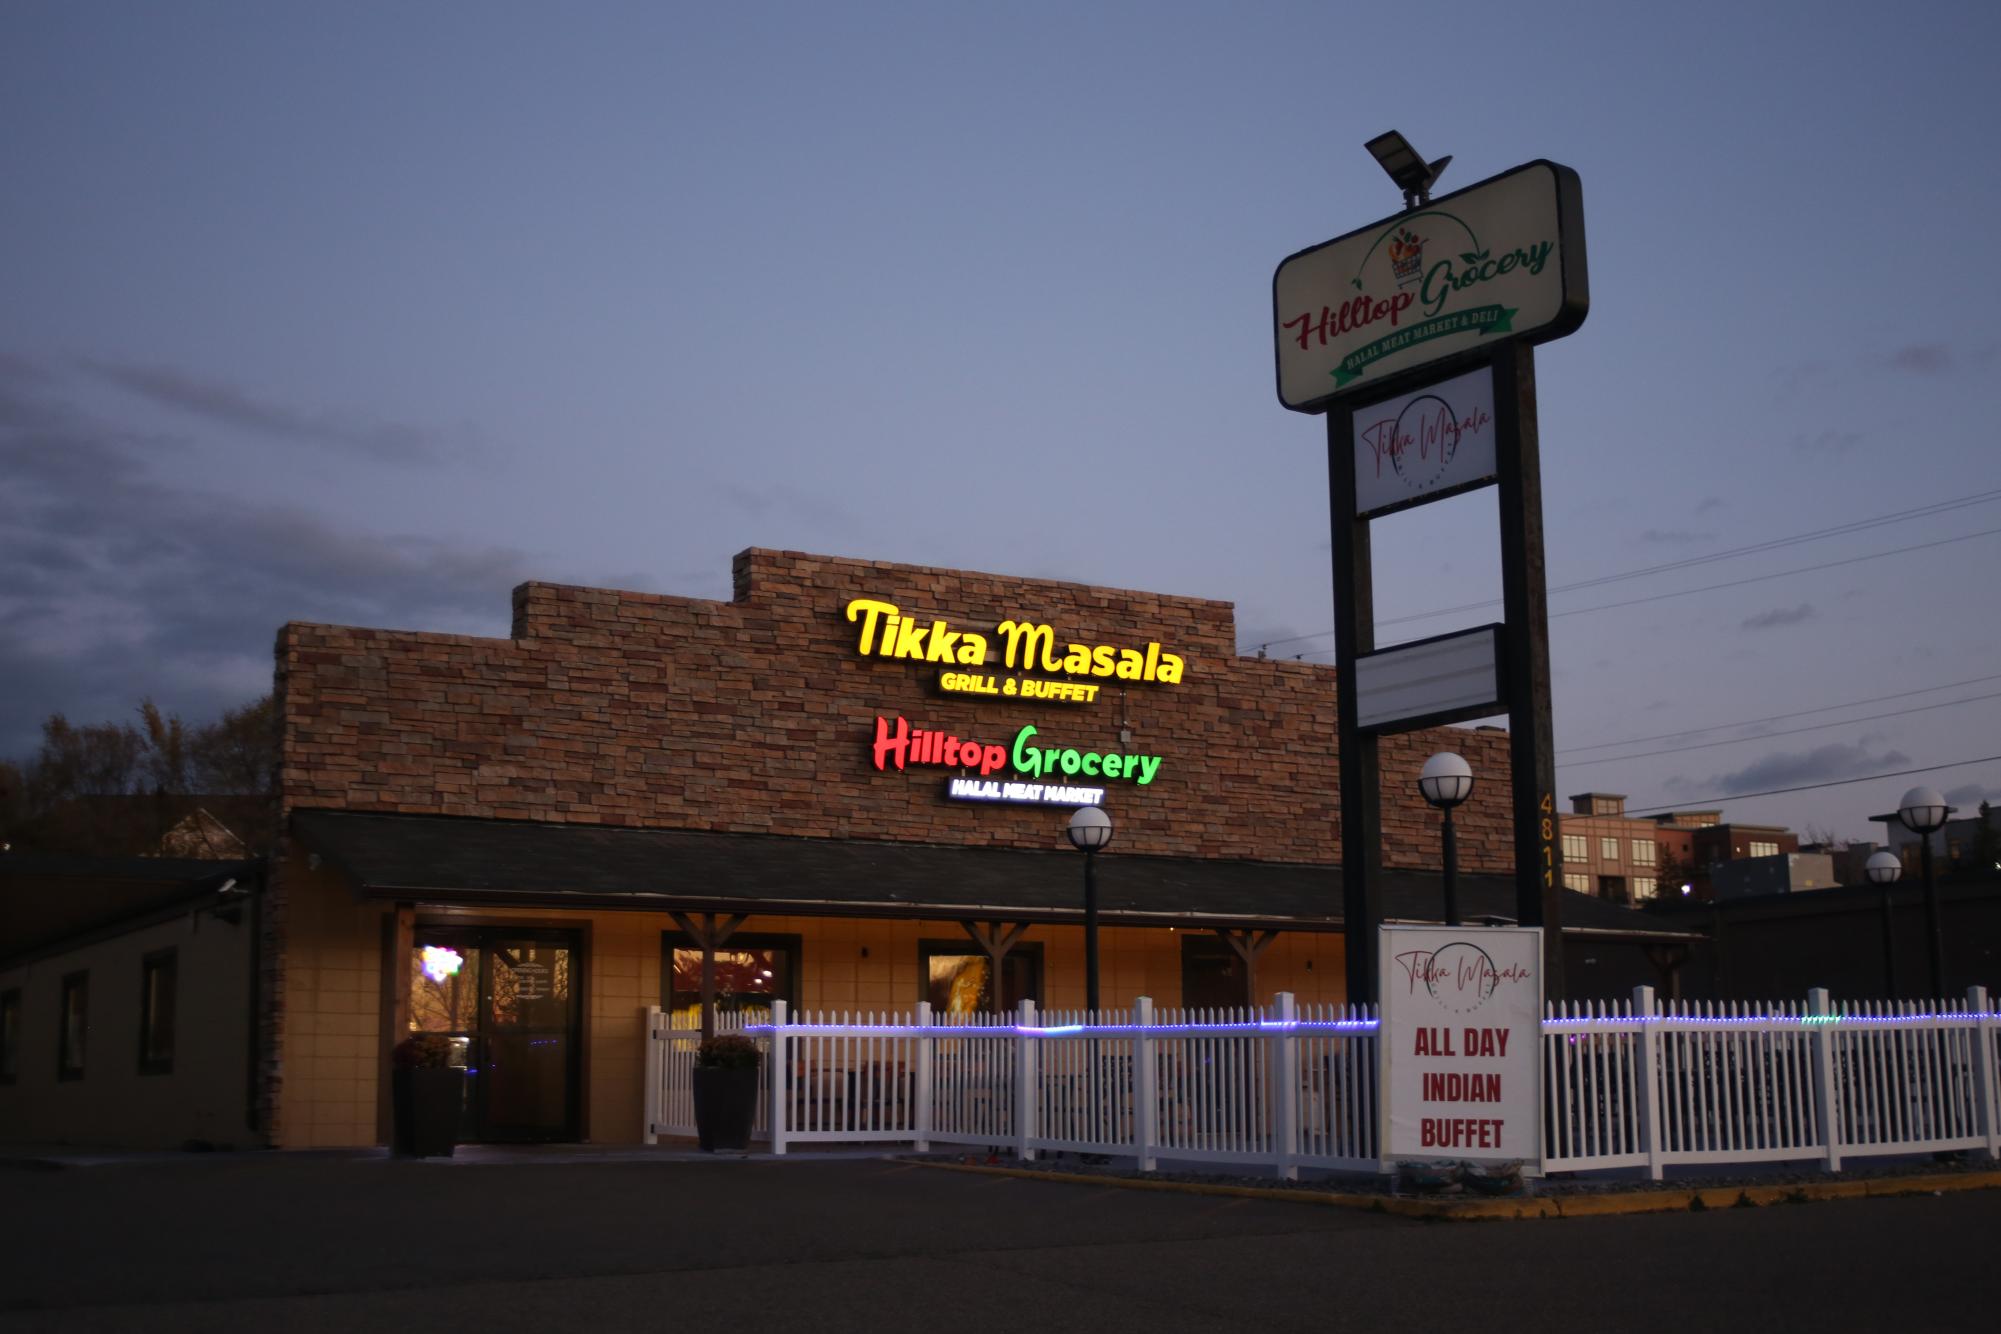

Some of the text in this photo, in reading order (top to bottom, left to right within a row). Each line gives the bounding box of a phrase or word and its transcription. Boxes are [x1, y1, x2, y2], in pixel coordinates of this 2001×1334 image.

[1283, 241, 1554, 350] Hilltop Grocery
[1346, 310, 1499, 370] HALAL MEAT MARKET & DELI
[1361, 419, 1415, 479] Tikka
[1420, 406, 1491, 464] Masala
[846, 598, 1185, 686] Tikka Masala
[939, 672, 1099, 703] GRILL & BUFFET
[872, 714, 1163, 786] Hilltop Grocery
[951, 778, 1104, 805] HALAL MEAT MARKET
[1540, 792, 1553, 889] 4811
[1395, 950, 1531, 997] Tikka Masala
[1414, 1027, 1510, 1057] ALL DAY
[1423, 1072, 1501, 1102] INDIAN
[1421, 1118, 1504, 1148] BUFFET
